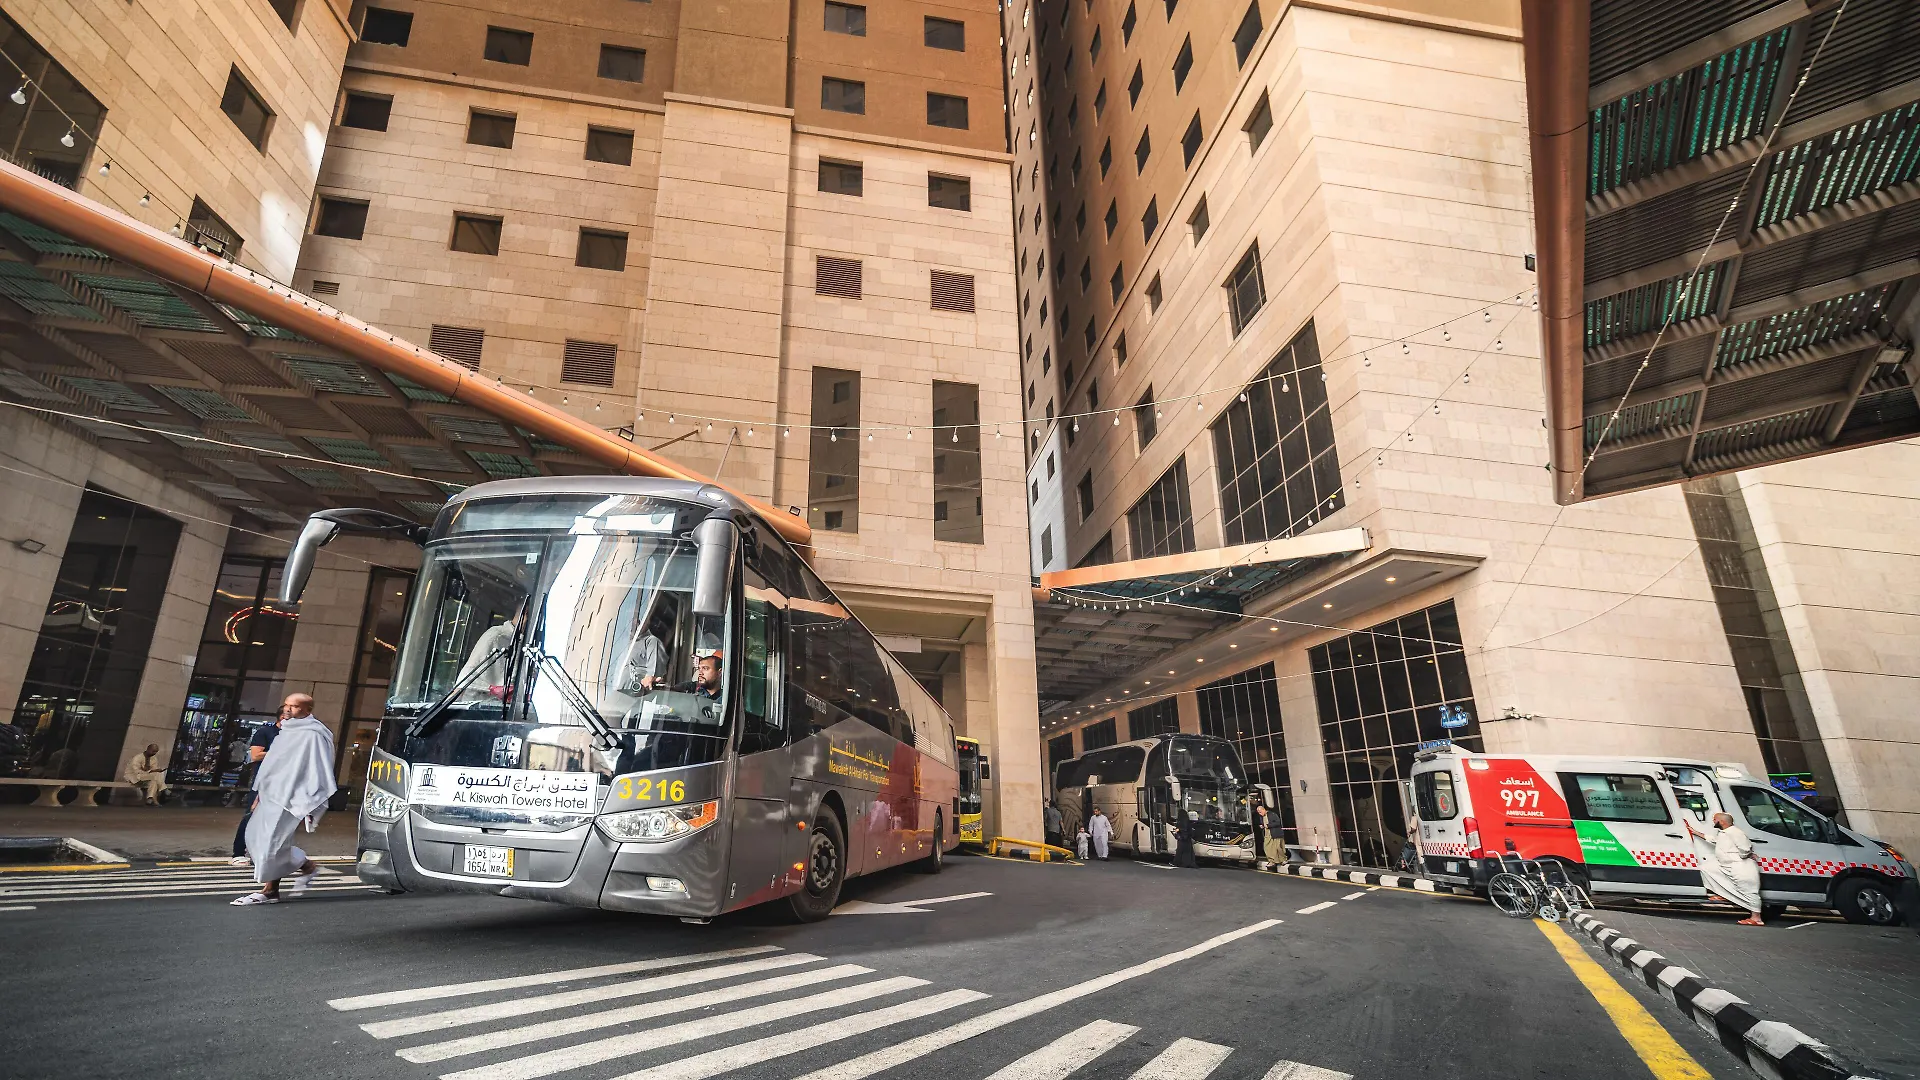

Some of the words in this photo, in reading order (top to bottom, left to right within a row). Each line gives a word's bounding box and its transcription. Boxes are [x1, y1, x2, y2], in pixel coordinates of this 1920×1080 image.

[458, 773, 513, 789] الكسوة
[513, 774, 545, 792] أبراج
[549, 776, 588, 793] فندق
[618, 777, 685, 802] 3216
[1499, 776, 1534, 787] إسعاف
[453, 791, 467, 802] AL
[469, 792, 508, 805] Kiswah
[511, 794, 552, 807] Towers
[555, 797, 588, 809] Hotel
[1500, 789, 1539, 807] 997
[468, 847, 487, 860] ١٦٥٤
[467, 860, 487, 873] 1654
[490, 864, 506, 874] NRA
